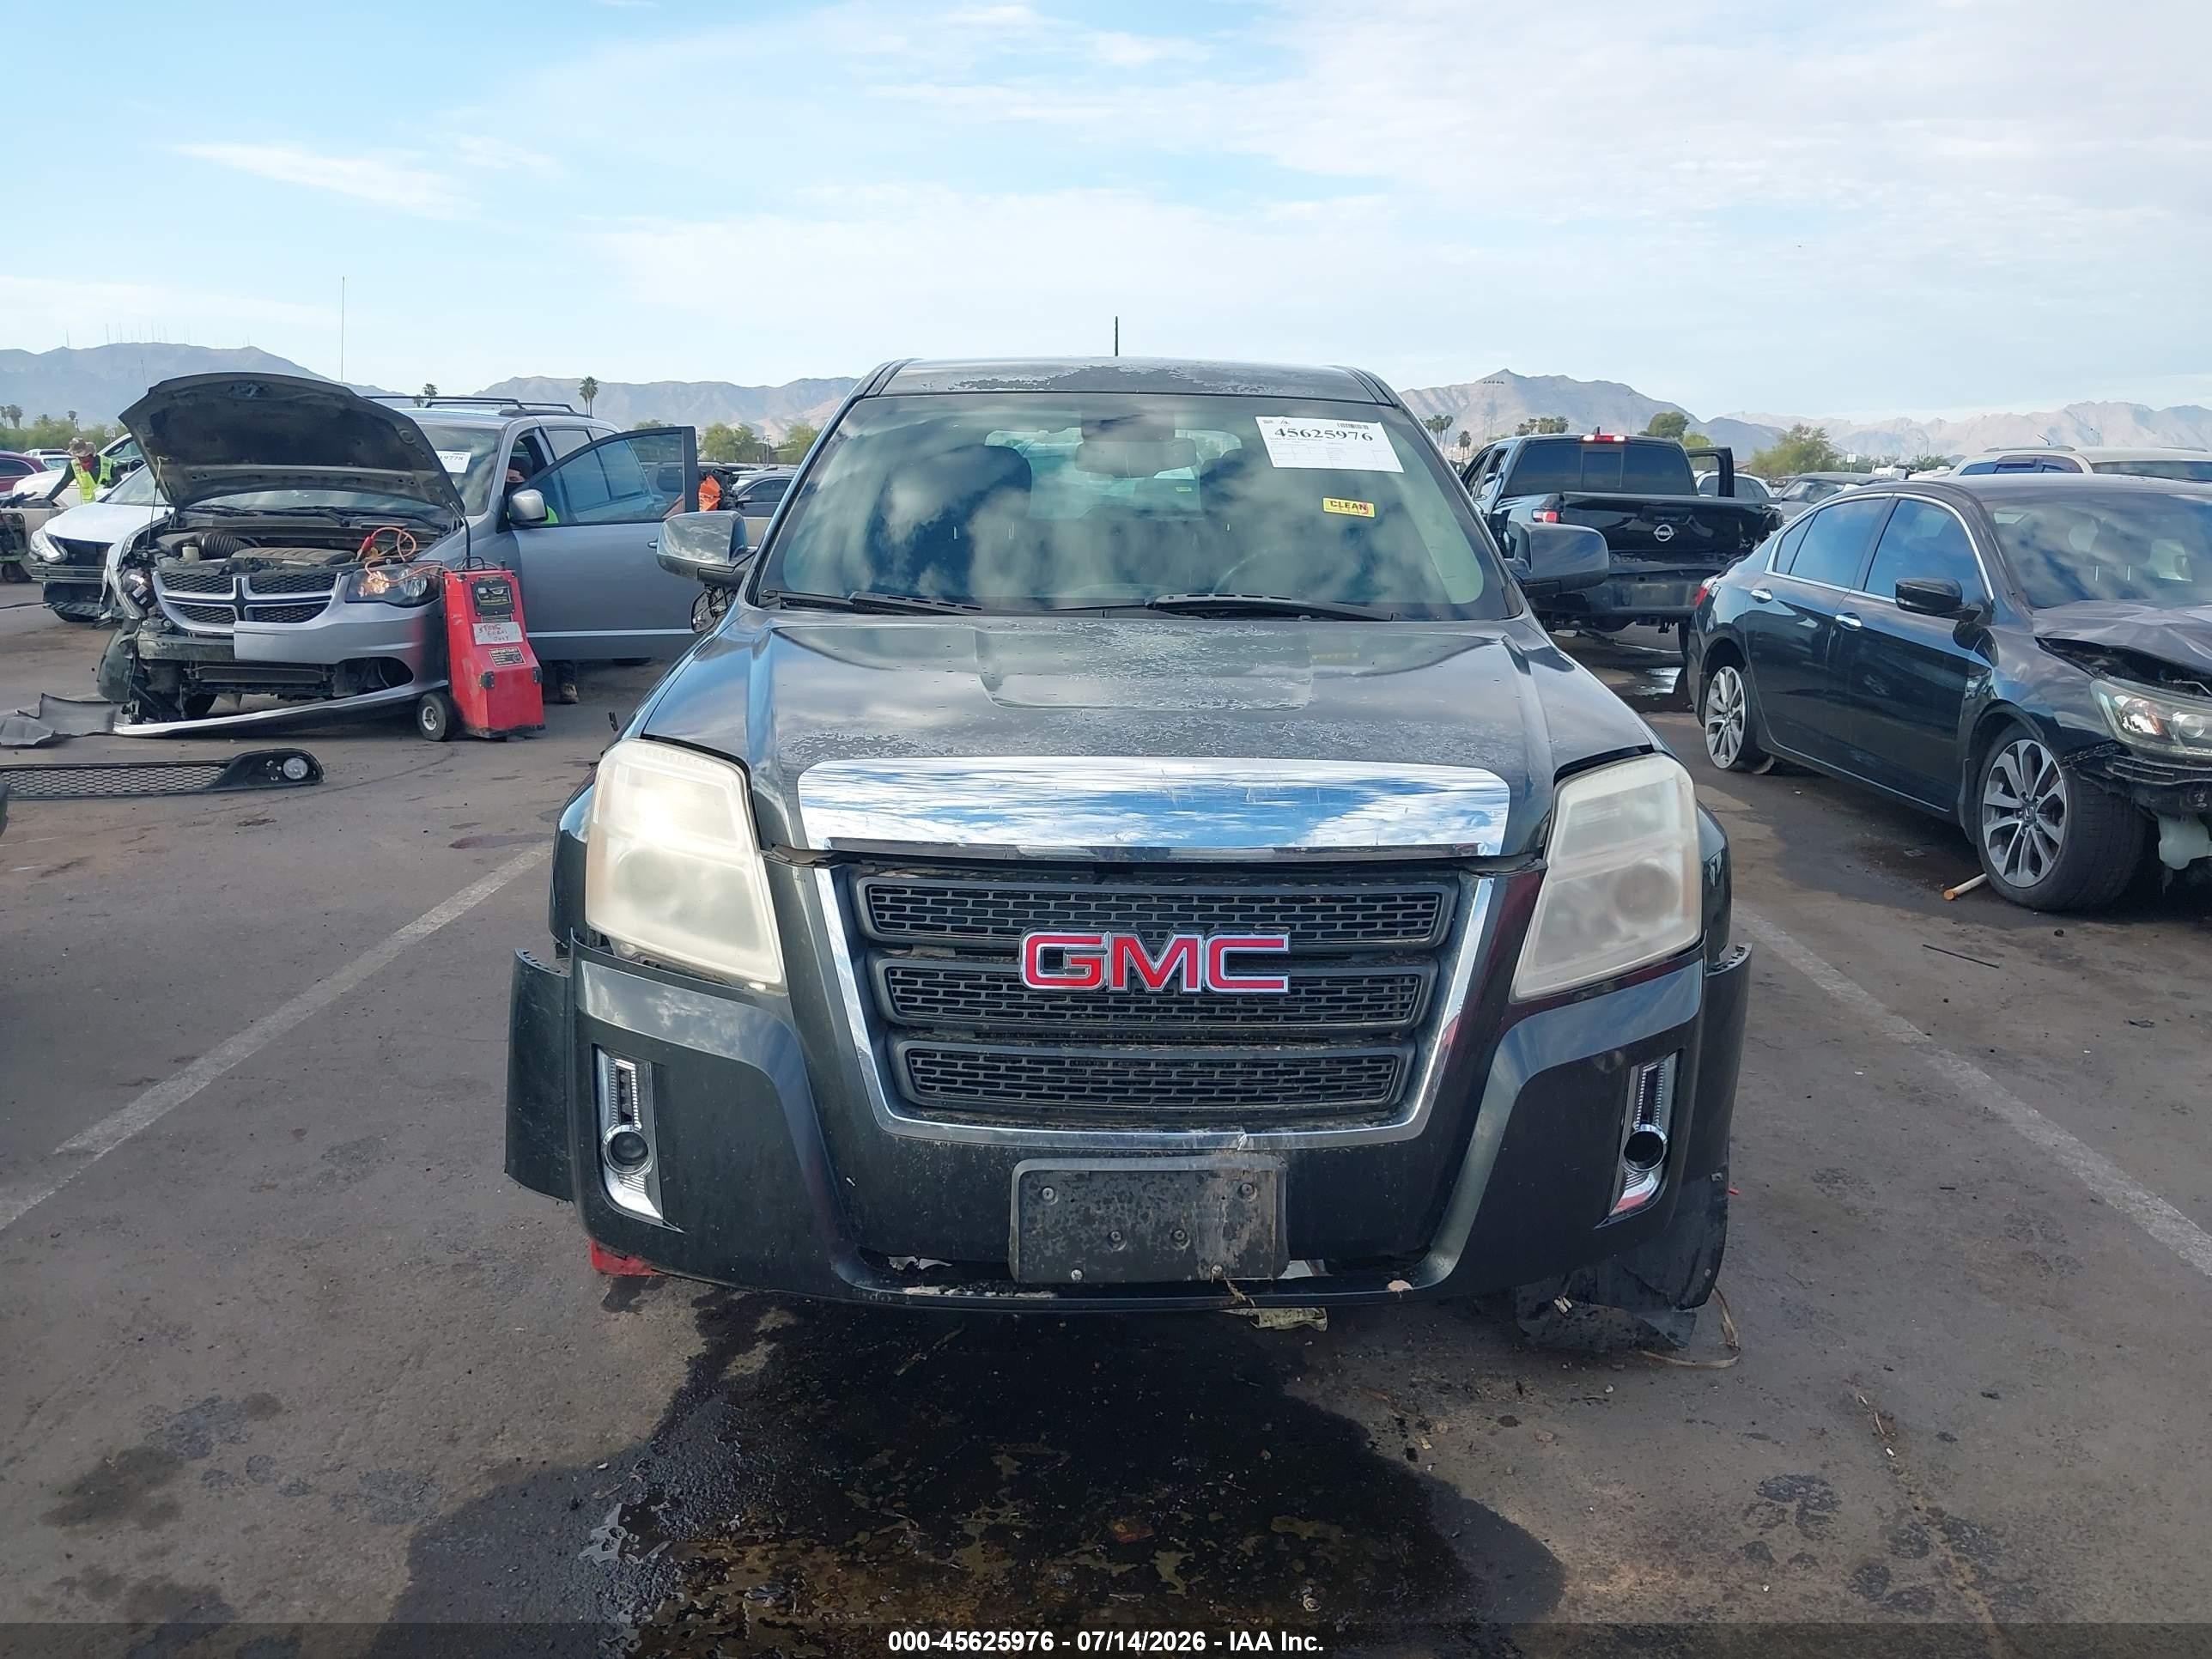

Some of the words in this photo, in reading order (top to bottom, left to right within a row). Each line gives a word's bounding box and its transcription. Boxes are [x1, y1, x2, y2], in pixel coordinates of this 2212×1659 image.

[1274, 428, 1373, 441] 45625976
[1330, 501, 1368, 512] CLEAN
[1022, 931, 1289, 993] GMC
